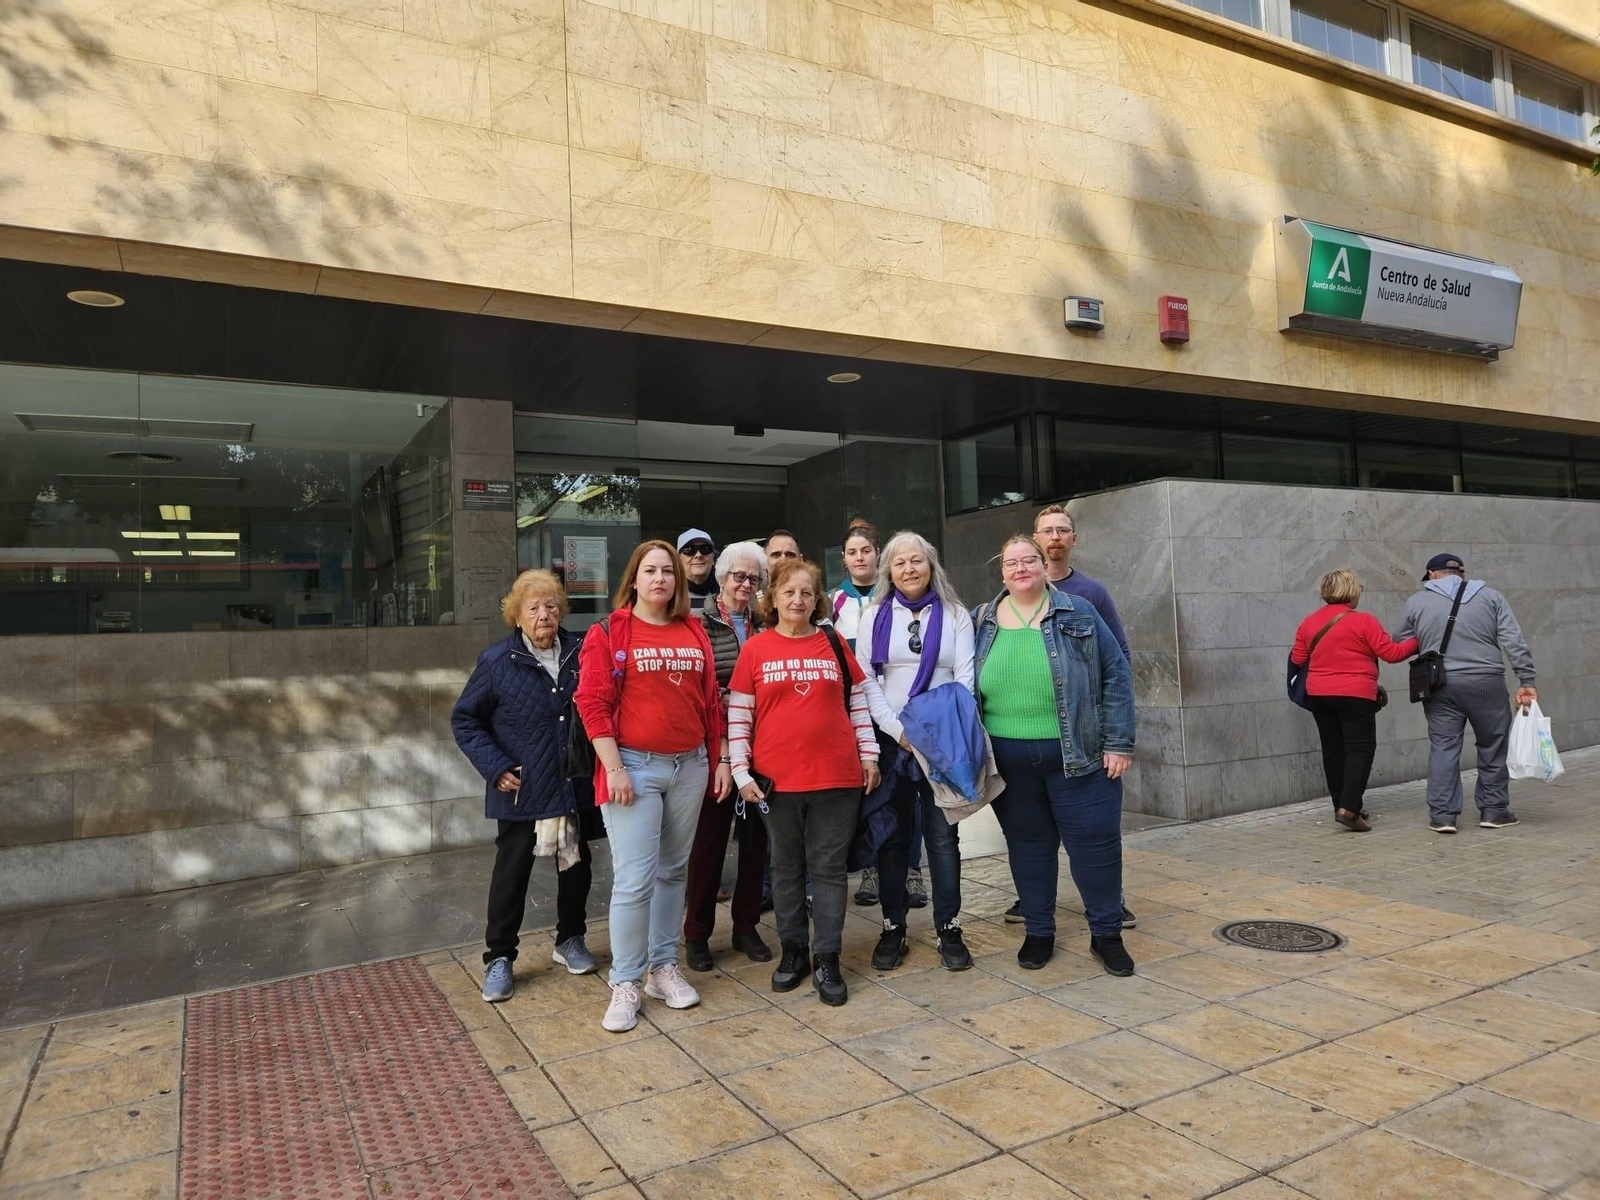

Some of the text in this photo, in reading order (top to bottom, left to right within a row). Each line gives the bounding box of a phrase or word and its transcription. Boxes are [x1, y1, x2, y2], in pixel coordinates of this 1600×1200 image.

[1311, 280, 1362, 295] Junta de Andalucía
[1380, 266, 1471, 297] Centro de Salud
[1168, 301, 1188, 311] FUEGO
[1377, 286, 1447, 311] Nueva Andalucía
[632, 647, 658, 659] IZAN
[659, 647, 674, 658] NO
[636, 659, 663, 672] STOP
[666, 658, 692, 671] Falso
[762, 658, 838, 673] IZAN NO MIENTE
[763, 671, 788, 684] STOP
[790, 669, 820, 681] Falso
